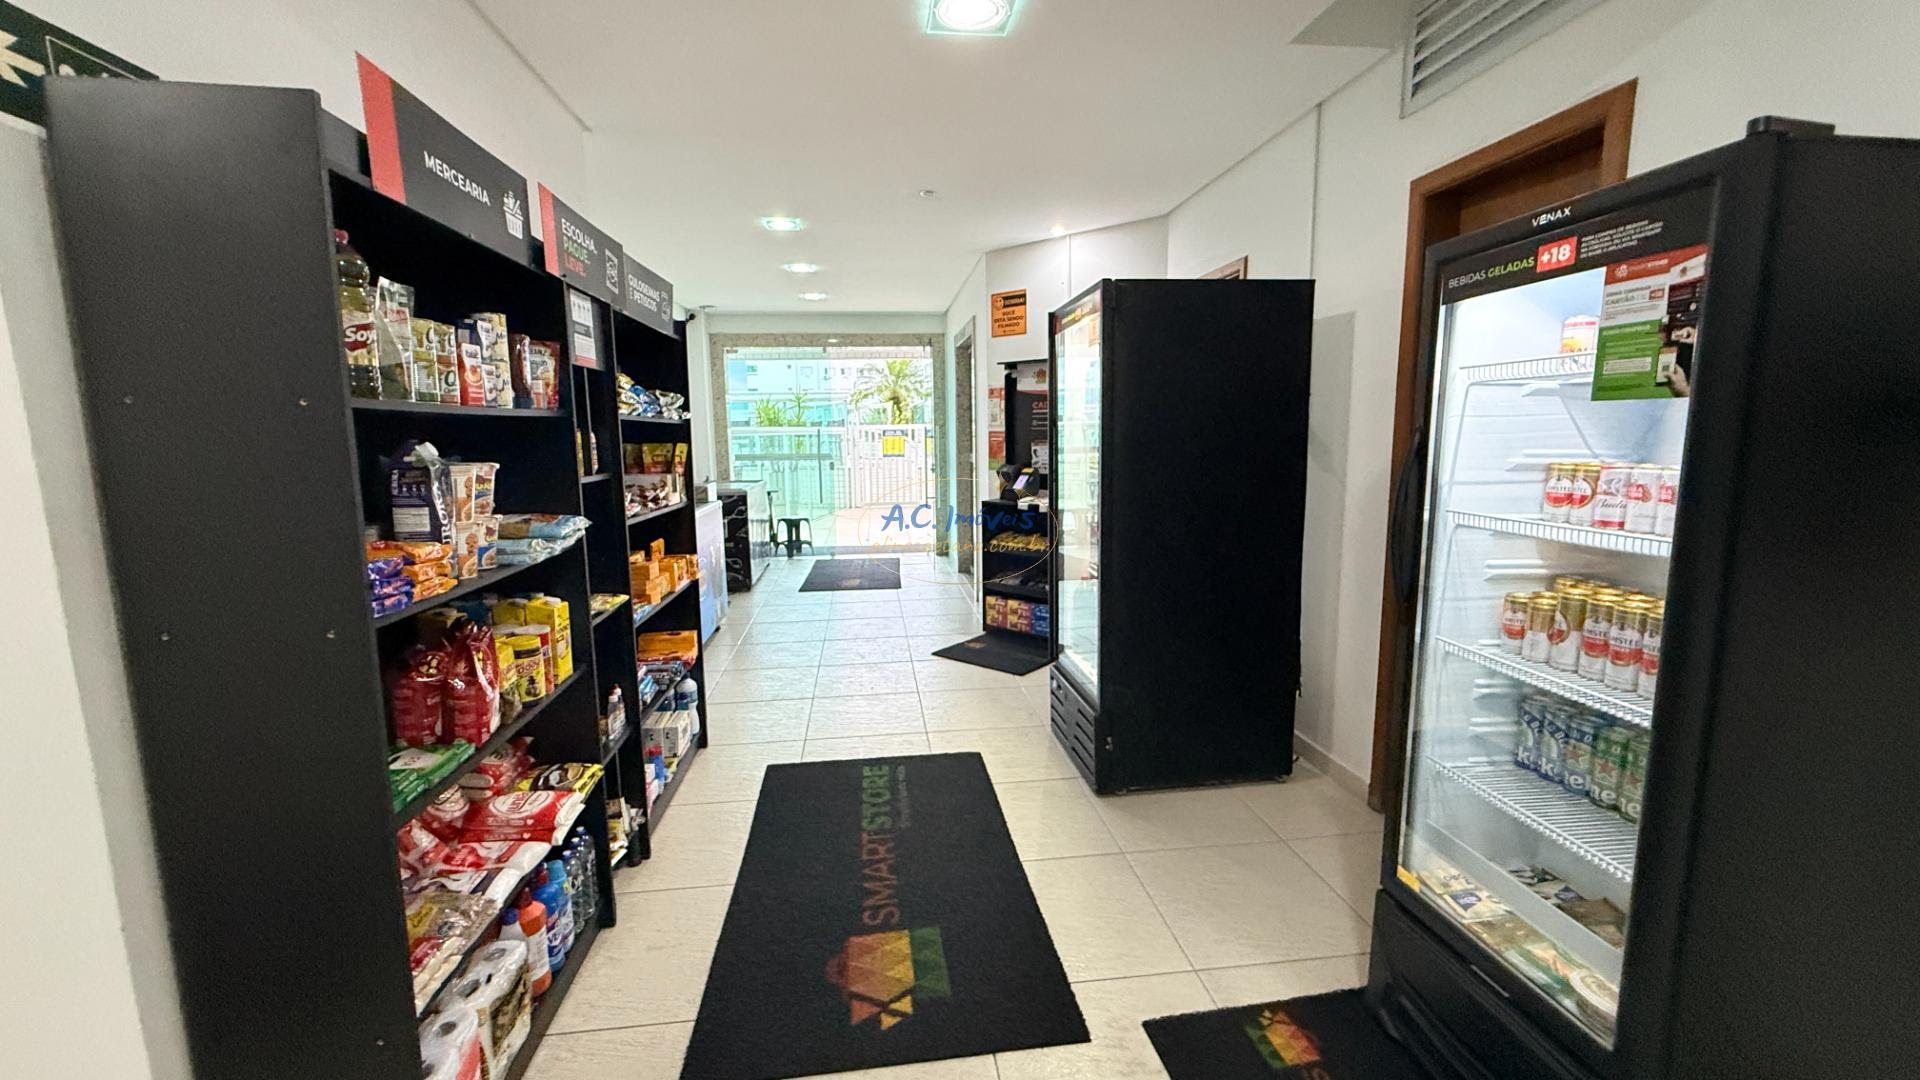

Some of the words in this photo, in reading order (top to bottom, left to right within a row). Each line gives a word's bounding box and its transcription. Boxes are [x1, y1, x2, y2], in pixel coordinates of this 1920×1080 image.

[423, 150, 491, 206] MERCEARIA
[1532, 206, 1571, 227] VENAX
[1448, 269, 1487, 289] BEBIDAS
[1488, 256, 1535, 278] GELADAS
[1540, 245, 1571, 265] +18
